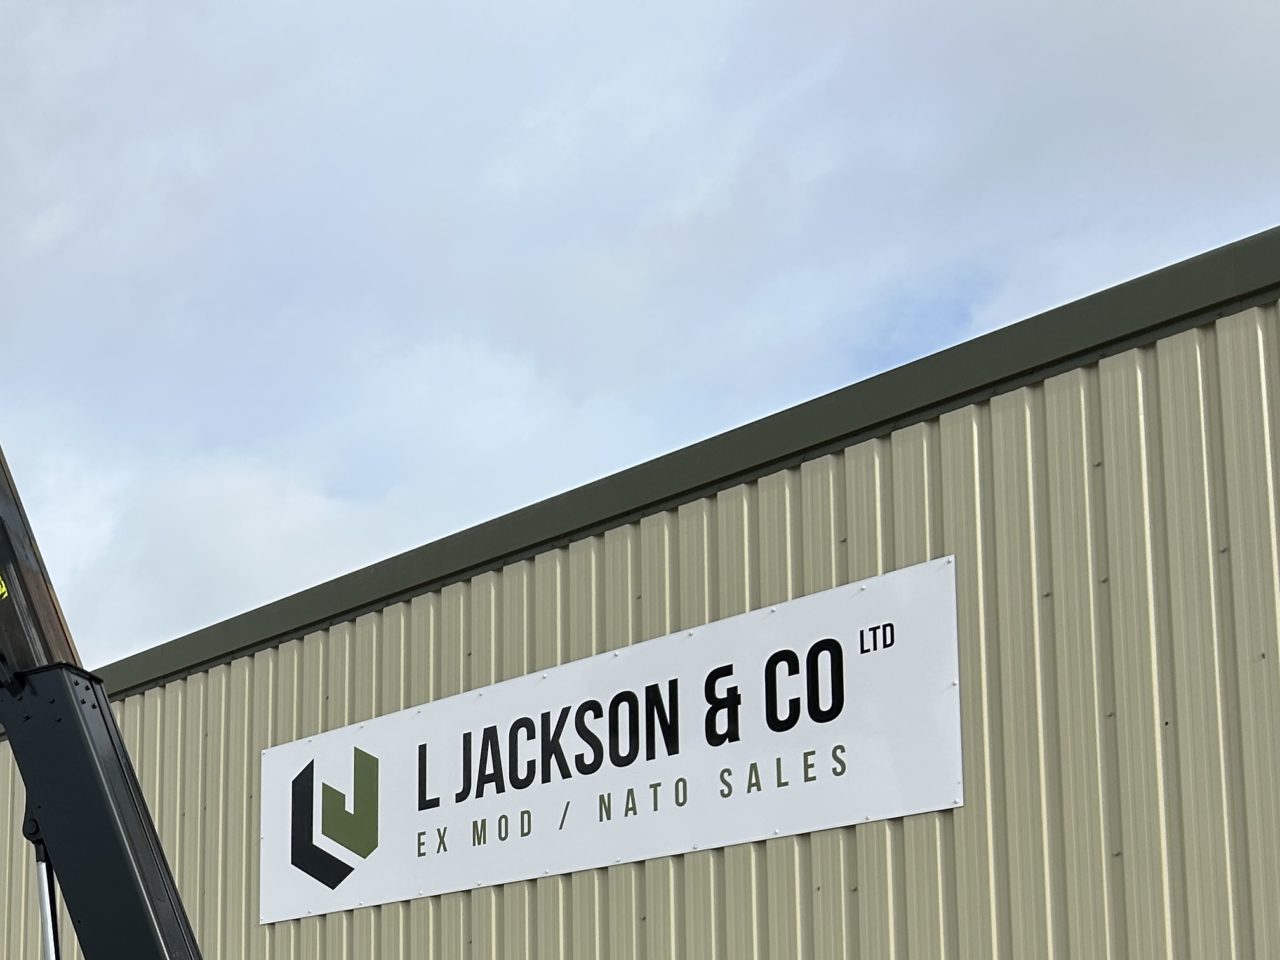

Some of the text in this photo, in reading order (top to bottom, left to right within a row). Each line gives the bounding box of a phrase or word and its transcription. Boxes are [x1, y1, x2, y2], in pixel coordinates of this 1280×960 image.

[417, 622, 895, 812] L JACKSON & CO LTD
[417, 826, 448, 858] EX
[472, 809, 532, 847] MOD
[598, 777, 688, 823] NATO
[719, 744, 847, 799] SALES
